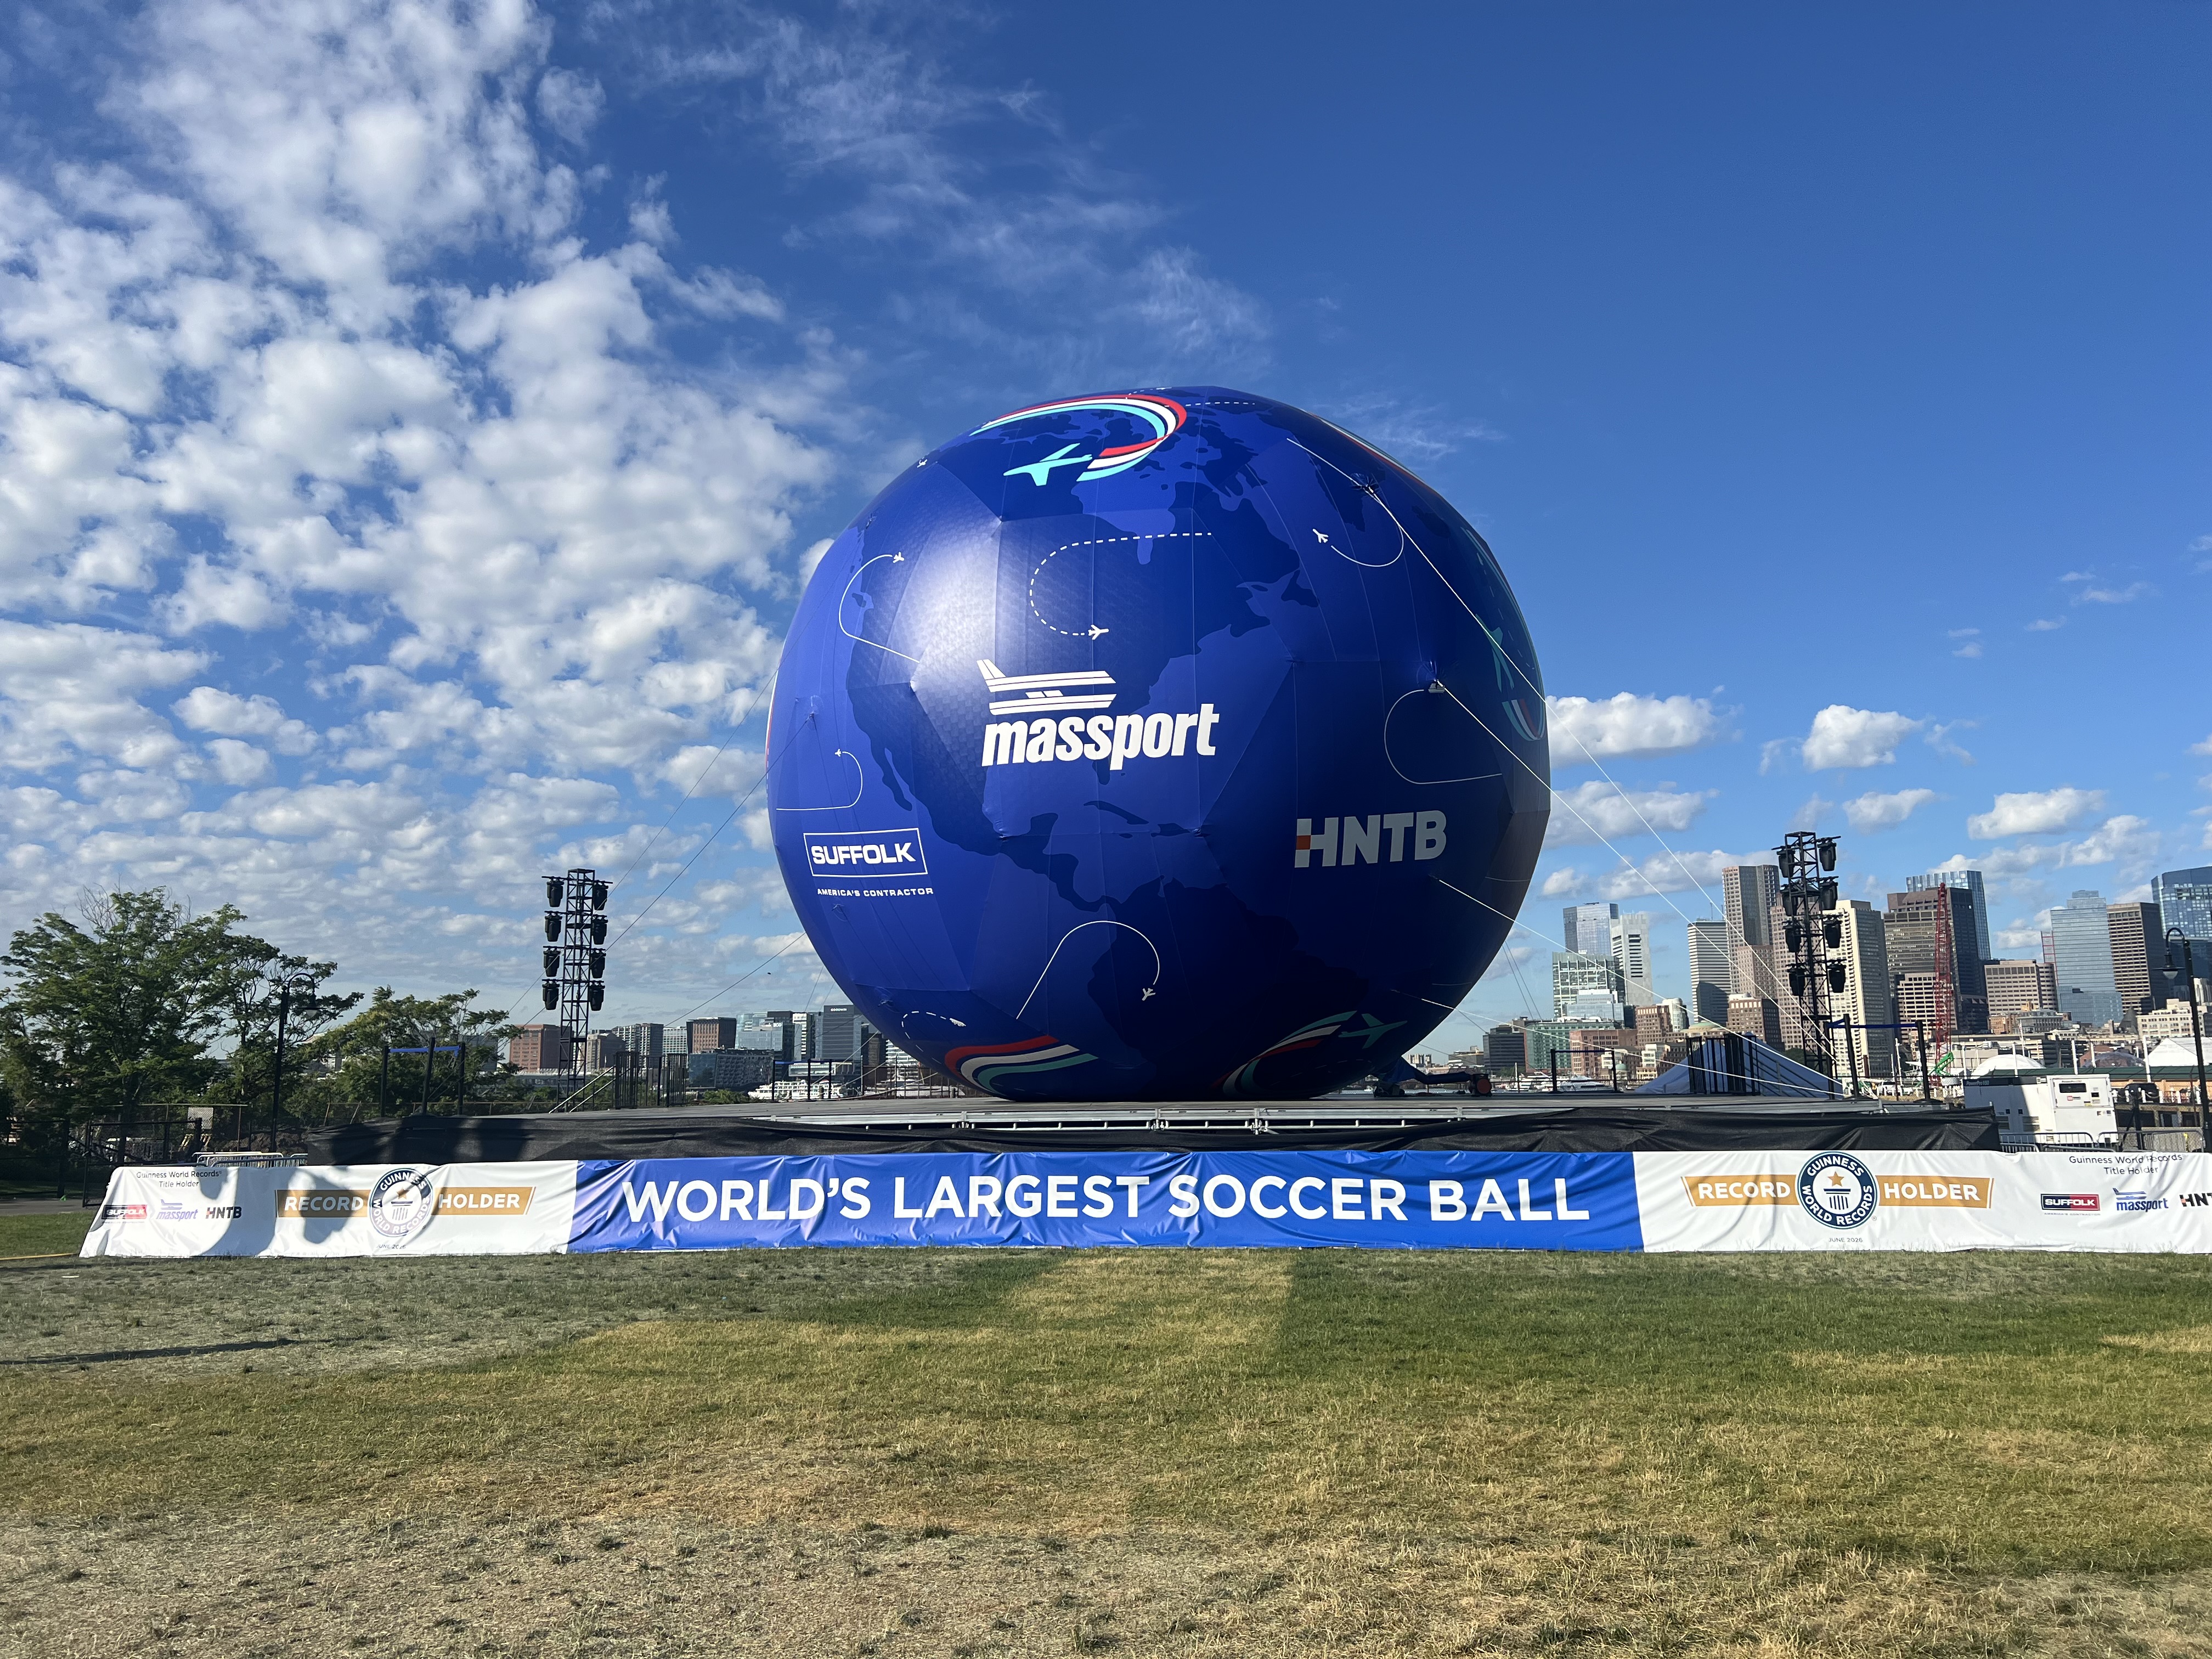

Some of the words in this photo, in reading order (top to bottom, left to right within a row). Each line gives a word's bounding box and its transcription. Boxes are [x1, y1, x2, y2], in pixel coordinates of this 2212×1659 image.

[982, 703, 1220, 770] massport
[1294, 810, 1447, 868] HNTB
[811, 842, 916, 865] SUFFOLK
[817, 888, 860, 896] AMERICA'S
[864, 888, 933, 897] CONTRACTOR
[1807, 1155, 1864, 1176] GUINNESS
[2069, 1155, 2112, 1164] Guinness
[2115, 1155, 2144, 1164] World
[2104, 1166, 2125, 1175] Title
[2128, 1166, 2158, 1175] Holder
[380, 1172, 427, 1190] GUINNESS
[1698, 1181, 1791, 1199] RECORD
[623, 1177, 871, 1223] WORLD’S
[893, 1174, 1150, 1220] LARGEST
[1168, 1174, 1409, 1221] SOCCER
[1430, 1177, 1590, 1221] BALL
[1884, 1182, 1980, 1201] HOLDER
[284, 1196, 364, 1211] RECORD
[439, 1194, 521, 1209] HOLDER
[1802, 1184, 1832, 1222] WORLD
[1836, 1185, 1872, 1225] RECORDS
[2116, 1198, 2169, 1212] massport
[156, 1209, 198, 1222] massport
[205, 1206, 242, 1219] HNTB
[373, 1199, 390, 1231] WORLD
[392, 1196, 430, 1234] RECORDS
